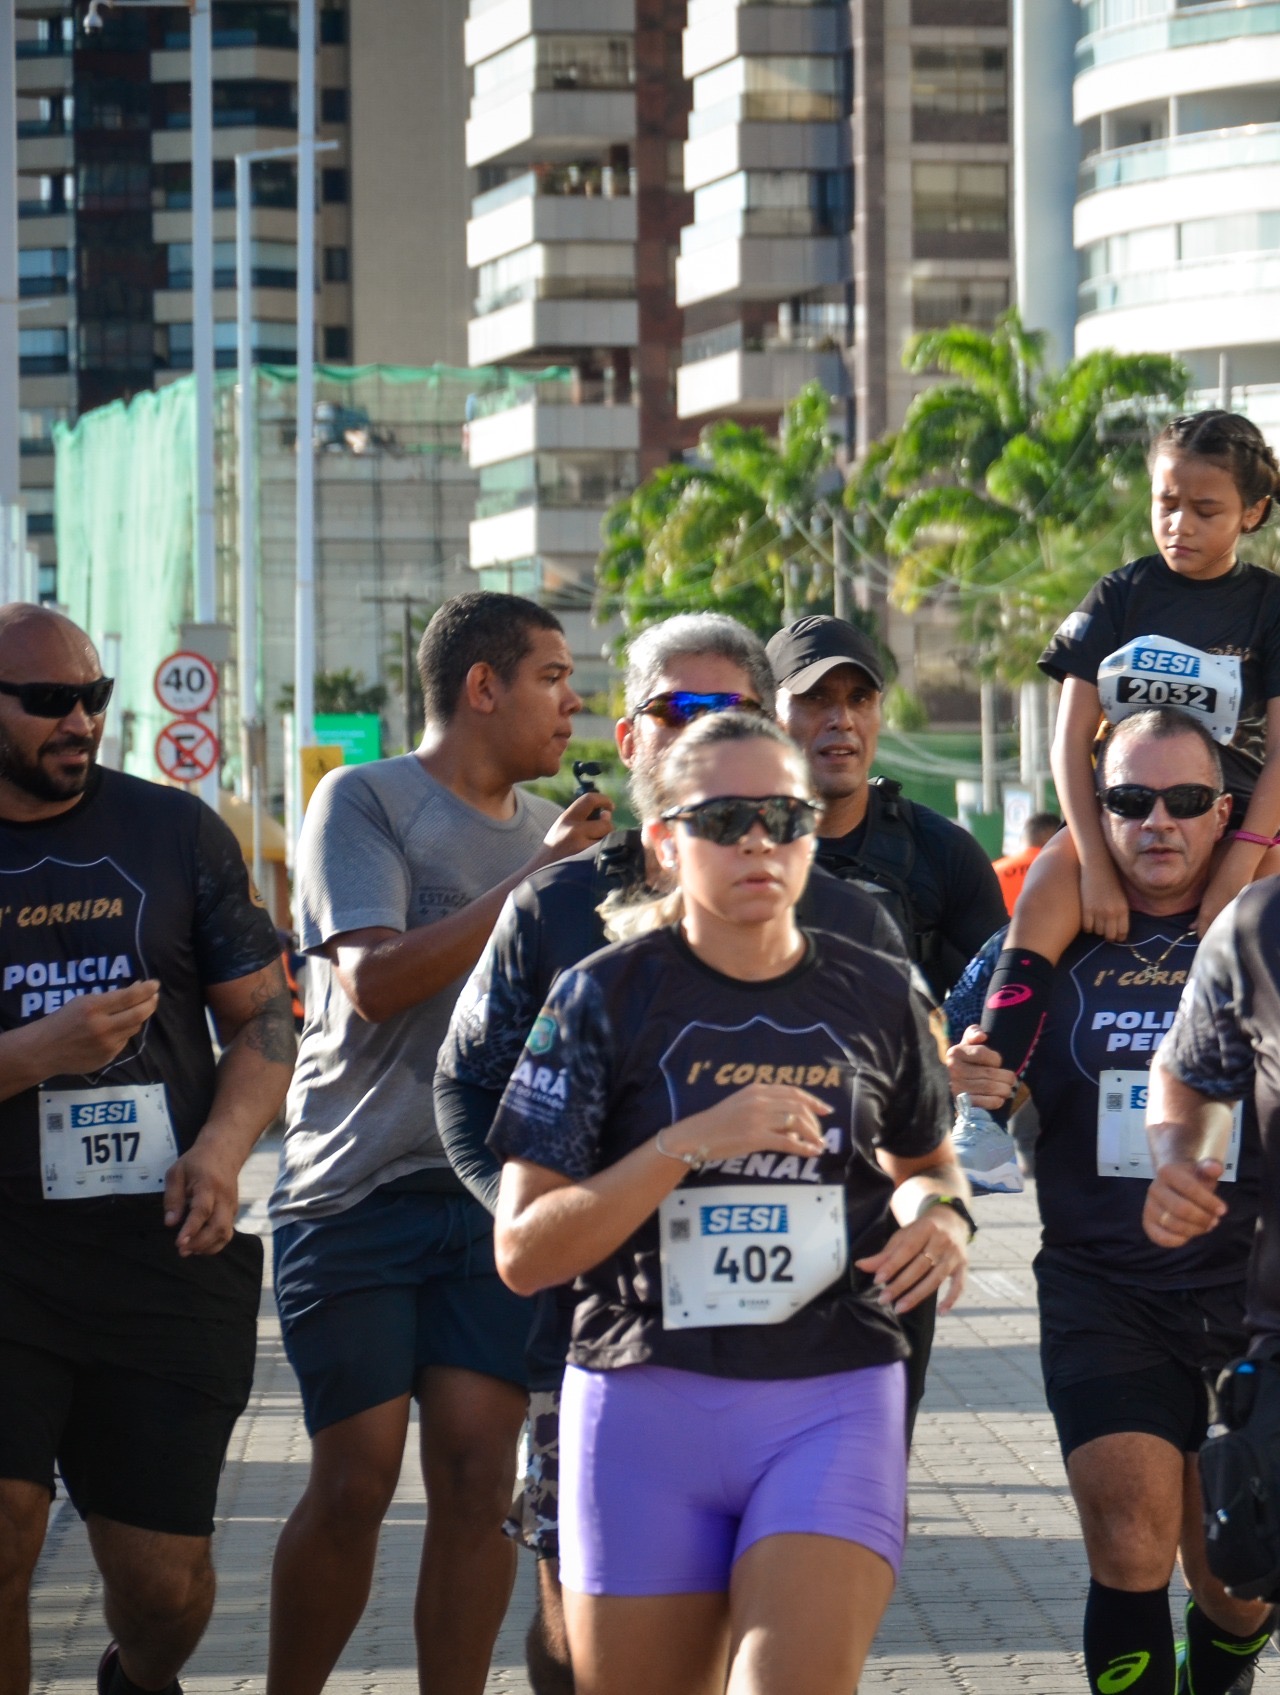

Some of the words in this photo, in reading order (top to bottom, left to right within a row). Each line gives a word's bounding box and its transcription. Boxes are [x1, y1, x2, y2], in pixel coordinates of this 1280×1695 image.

[1137, 651, 1196, 674] SESI
[164, 667, 206, 693] 40
[1127, 678, 1209, 711] 2032
[16, 897, 123, 928] CORRIDA
[1117, 970, 1188, 987] CORR
[1091, 1011, 1177, 1031] POLI
[509, 1060, 569, 1100] ARÁ
[714, 1062, 842, 1089] CORRIDA
[77, 1102, 132, 1126] SESI
[81, 1131, 140, 1166] 1517
[707, 1207, 782, 1233] SESI
[713, 1245, 794, 1284] 402
